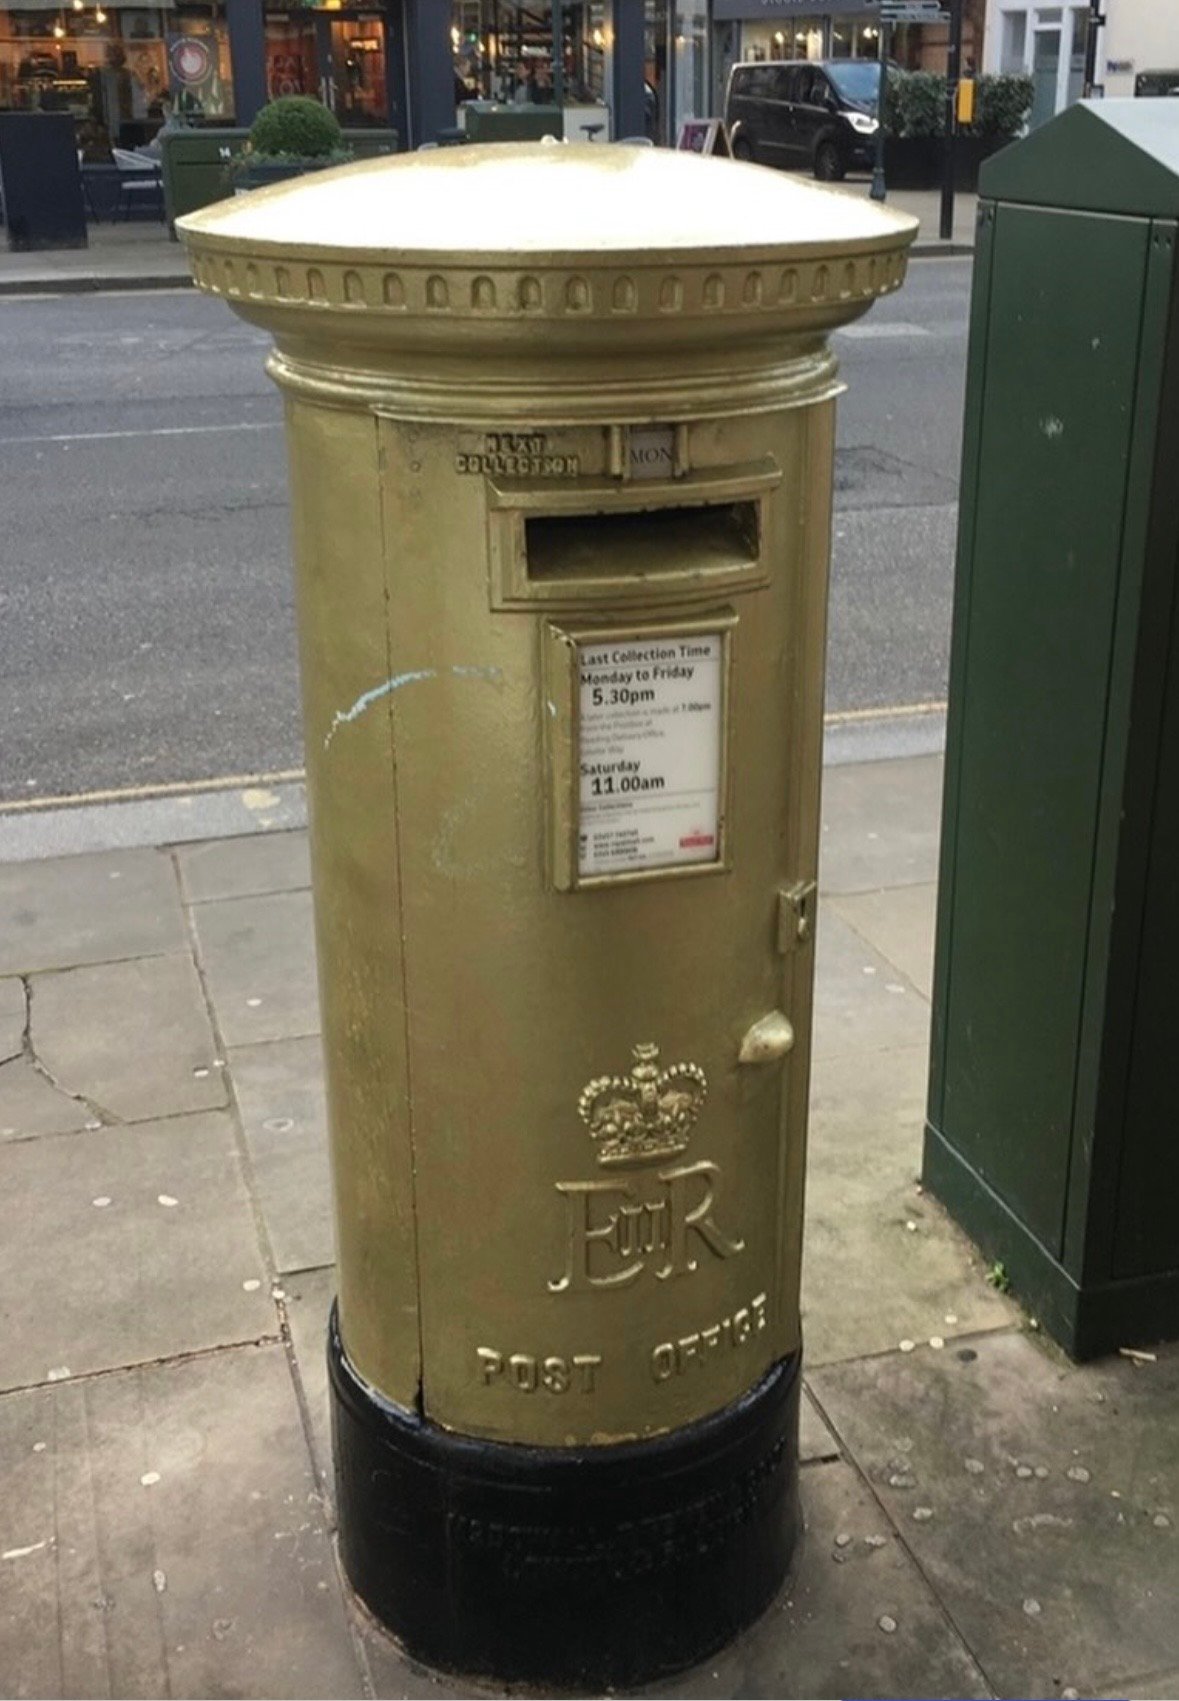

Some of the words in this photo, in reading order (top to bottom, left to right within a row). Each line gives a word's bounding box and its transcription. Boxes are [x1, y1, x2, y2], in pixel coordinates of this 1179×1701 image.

[455, 454, 580, 476] COLLECTION
[629, 447, 673, 464] MON
[580, 652, 608, 667] Last
[611, 647, 676, 663] Collection
[679, 644, 711, 658] Time
[580, 670, 633, 686] Monday
[636, 669, 650, 682] to
[653, 665, 695, 681] Friday
[592, 687, 655, 707] 5.30pm
[580, 760, 641, 777] Saturday
[591, 776, 665, 796] 11.00am
[476, 1346, 602, 1394] POST
[650, 1292, 768, 1384] OFFICE
